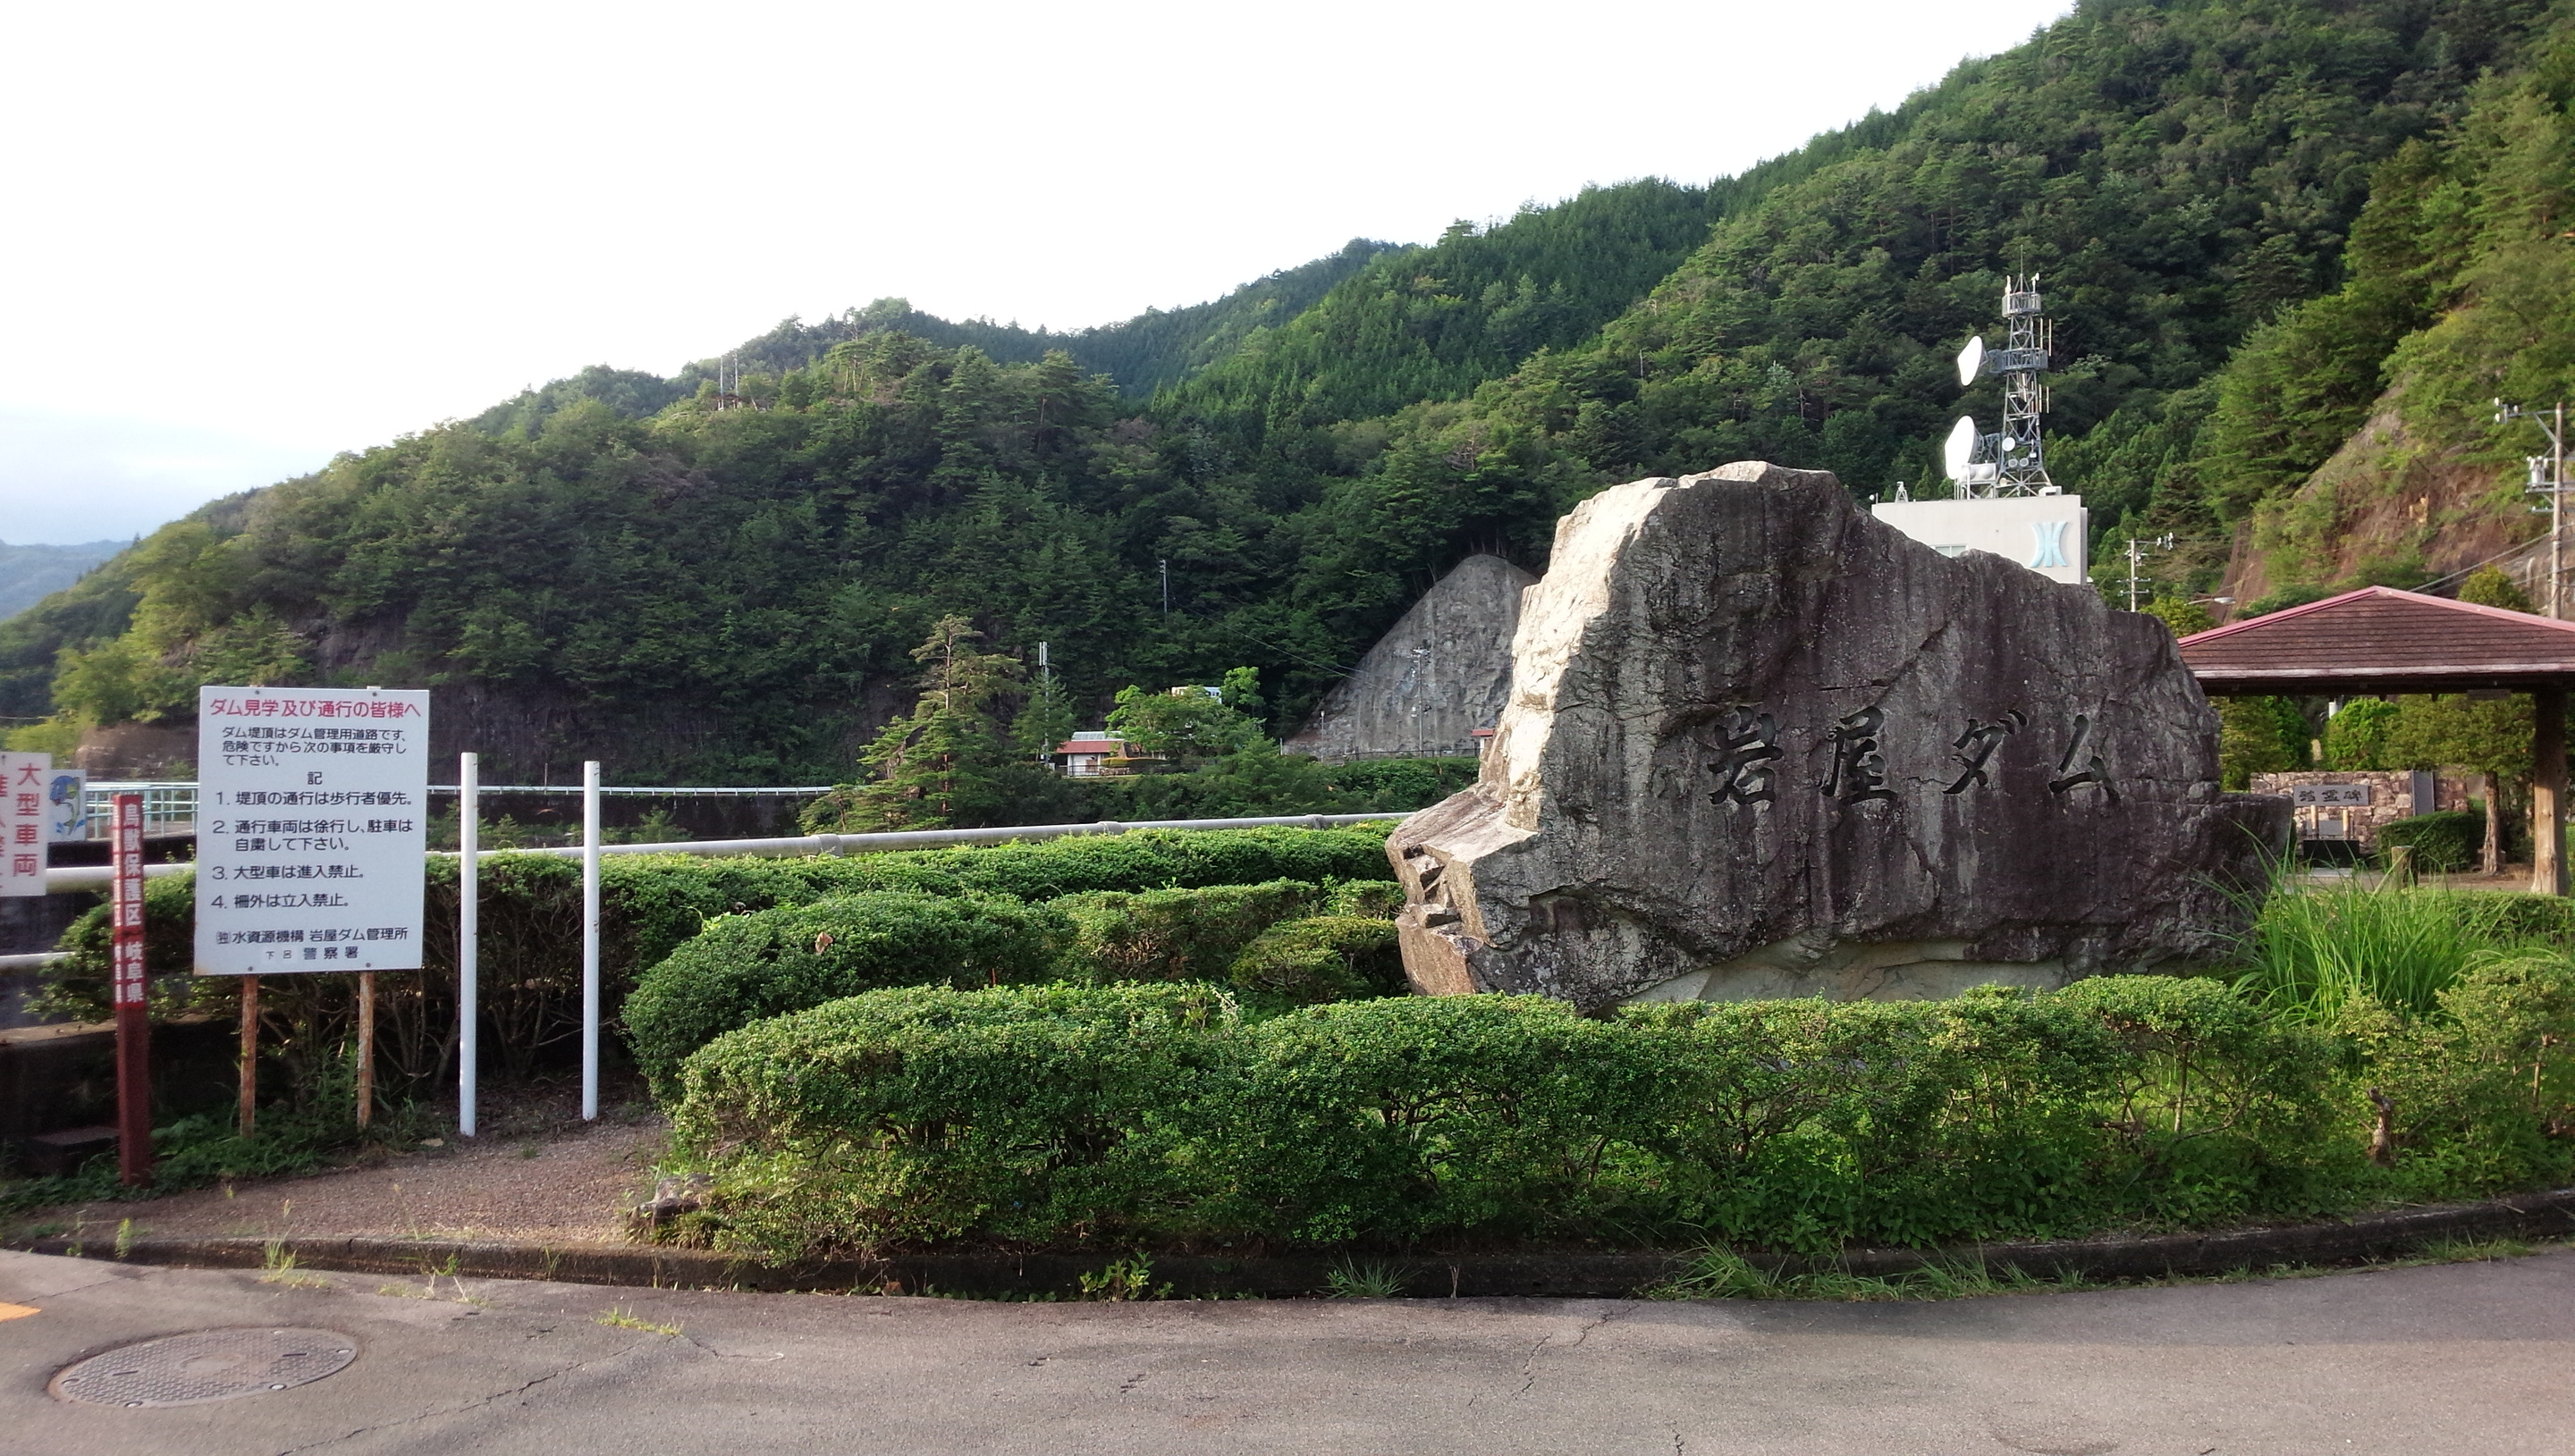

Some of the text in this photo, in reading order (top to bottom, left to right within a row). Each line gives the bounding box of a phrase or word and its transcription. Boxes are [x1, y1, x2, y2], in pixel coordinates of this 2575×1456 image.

[210, 699, 421, 719] ダム見学及び通行の皆様へ
[222, 740, 407, 755] 危険ですから次の事項を厳守し
[1707, 705, 2121, 804] 岩屋ダム
[224, 753, 280, 767] て下さい。
[307, 770, 323, 786] 記
[13, 762, 42, 878] 大型車両
[309, 927, 408, 943] 岩屋ダム管理所
[124, 941, 144, 1003] 岐阜県
